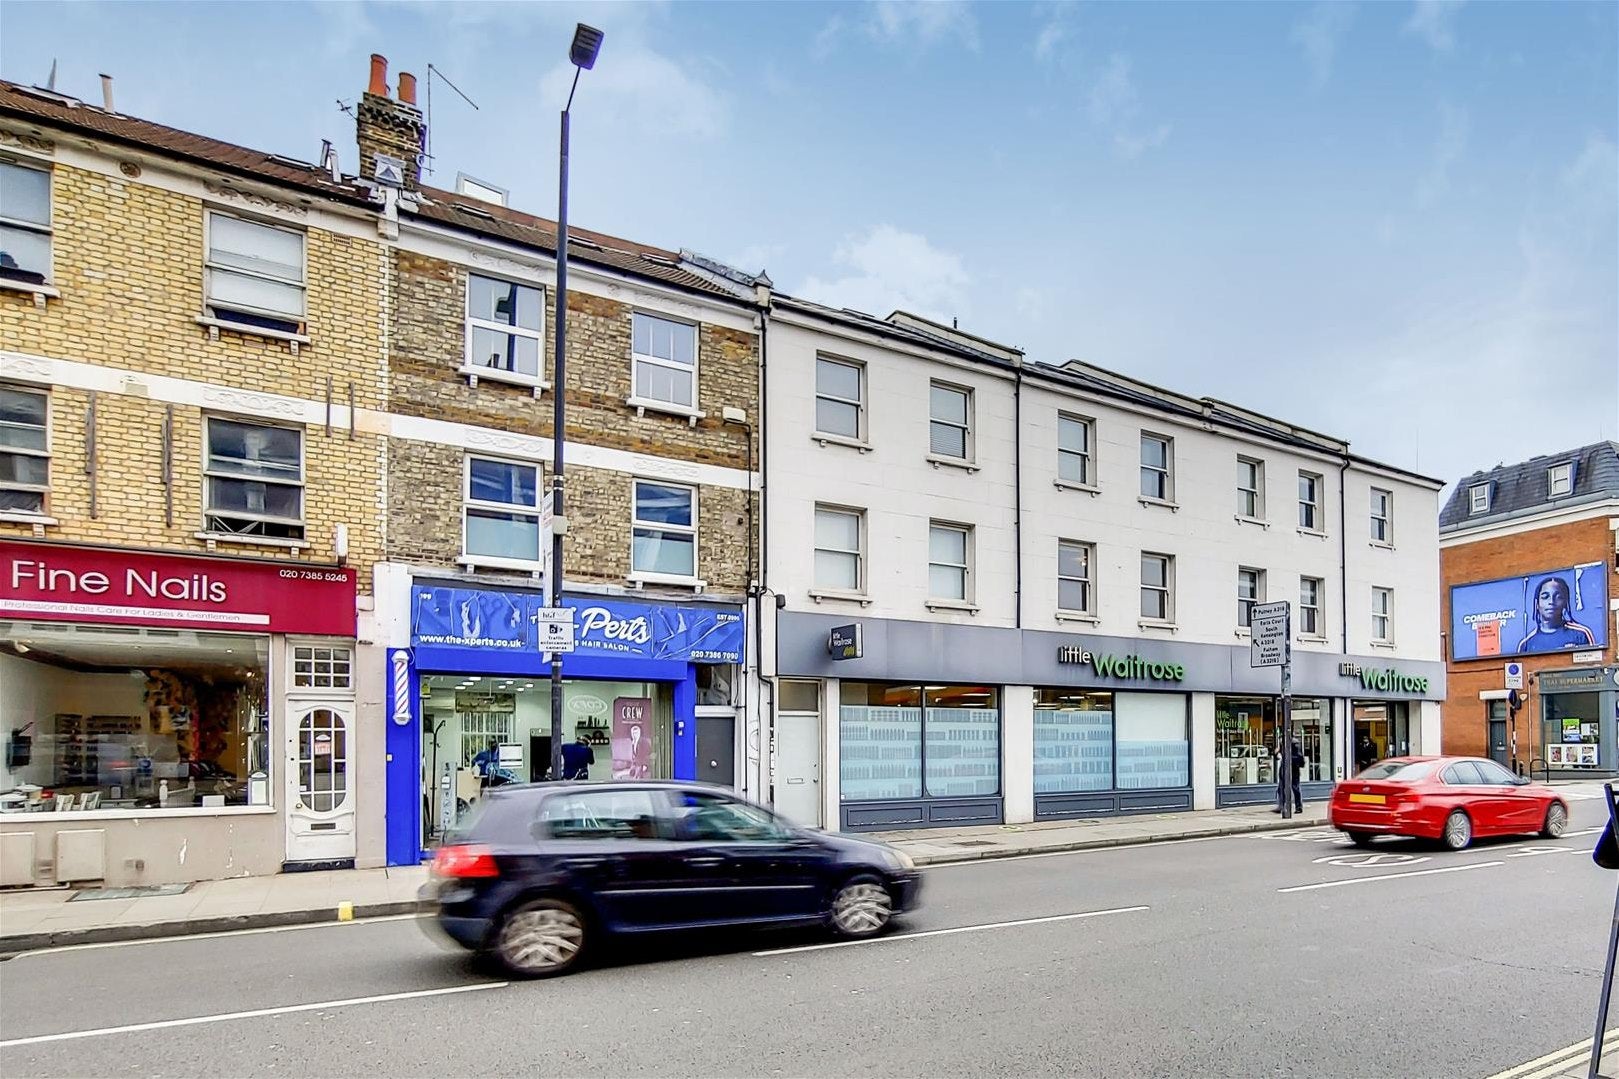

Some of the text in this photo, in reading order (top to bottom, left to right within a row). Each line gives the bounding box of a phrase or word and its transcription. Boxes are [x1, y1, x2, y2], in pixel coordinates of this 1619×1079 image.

[12, 559, 227, 603] Fine Nails
[279, 569, 298, 578] 020
[300, 571, 323, 580] 7385
[4, 600, 68, 611] Professional
[70, 604, 94, 613] Nails
[97, 606, 122, 614] Care
[143, 609, 174, 618] Ladies
[186, 612, 240, 621] Gentlemen
[1463, 610, 1517, 624] COMEBACK
[581, 639, 601, 648] HAIR
[603, 642, 630, 652] SALON
[690, 650, 704, 658] 020
[1059, 646, 1184, 681] little Waitrose
[1339, 662, 1429, 693] little Waitrose
[621, 706, 643, 719] CREW
[1216, 718, 1248, 728] Waitro
